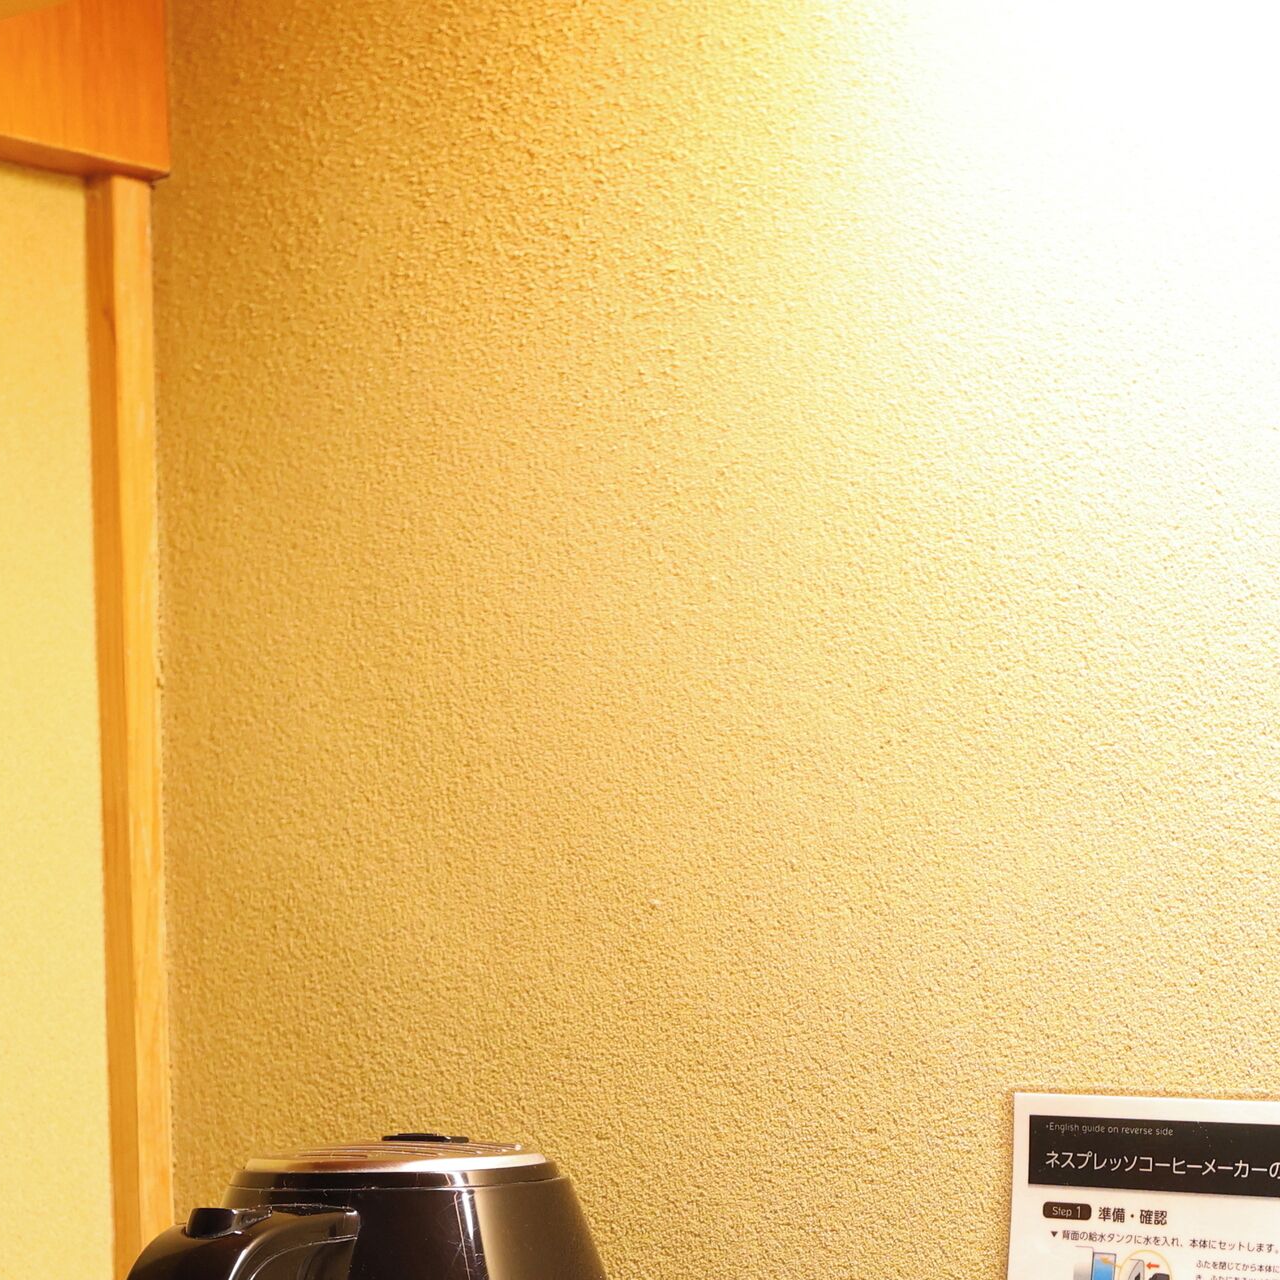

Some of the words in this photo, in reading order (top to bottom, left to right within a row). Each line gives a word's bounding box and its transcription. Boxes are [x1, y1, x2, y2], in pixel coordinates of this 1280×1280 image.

[1082, 1124, 1105, 1135] guide
[1108, 1126, 1119, 1134] on
[1121, 1126, 1153, 1136] reverse
[1156, 1127, 1174, 1136] side
[1052, 1206, 1072, 1218] Step
[1099, 1206, 1168, 1226] 準備・確認
